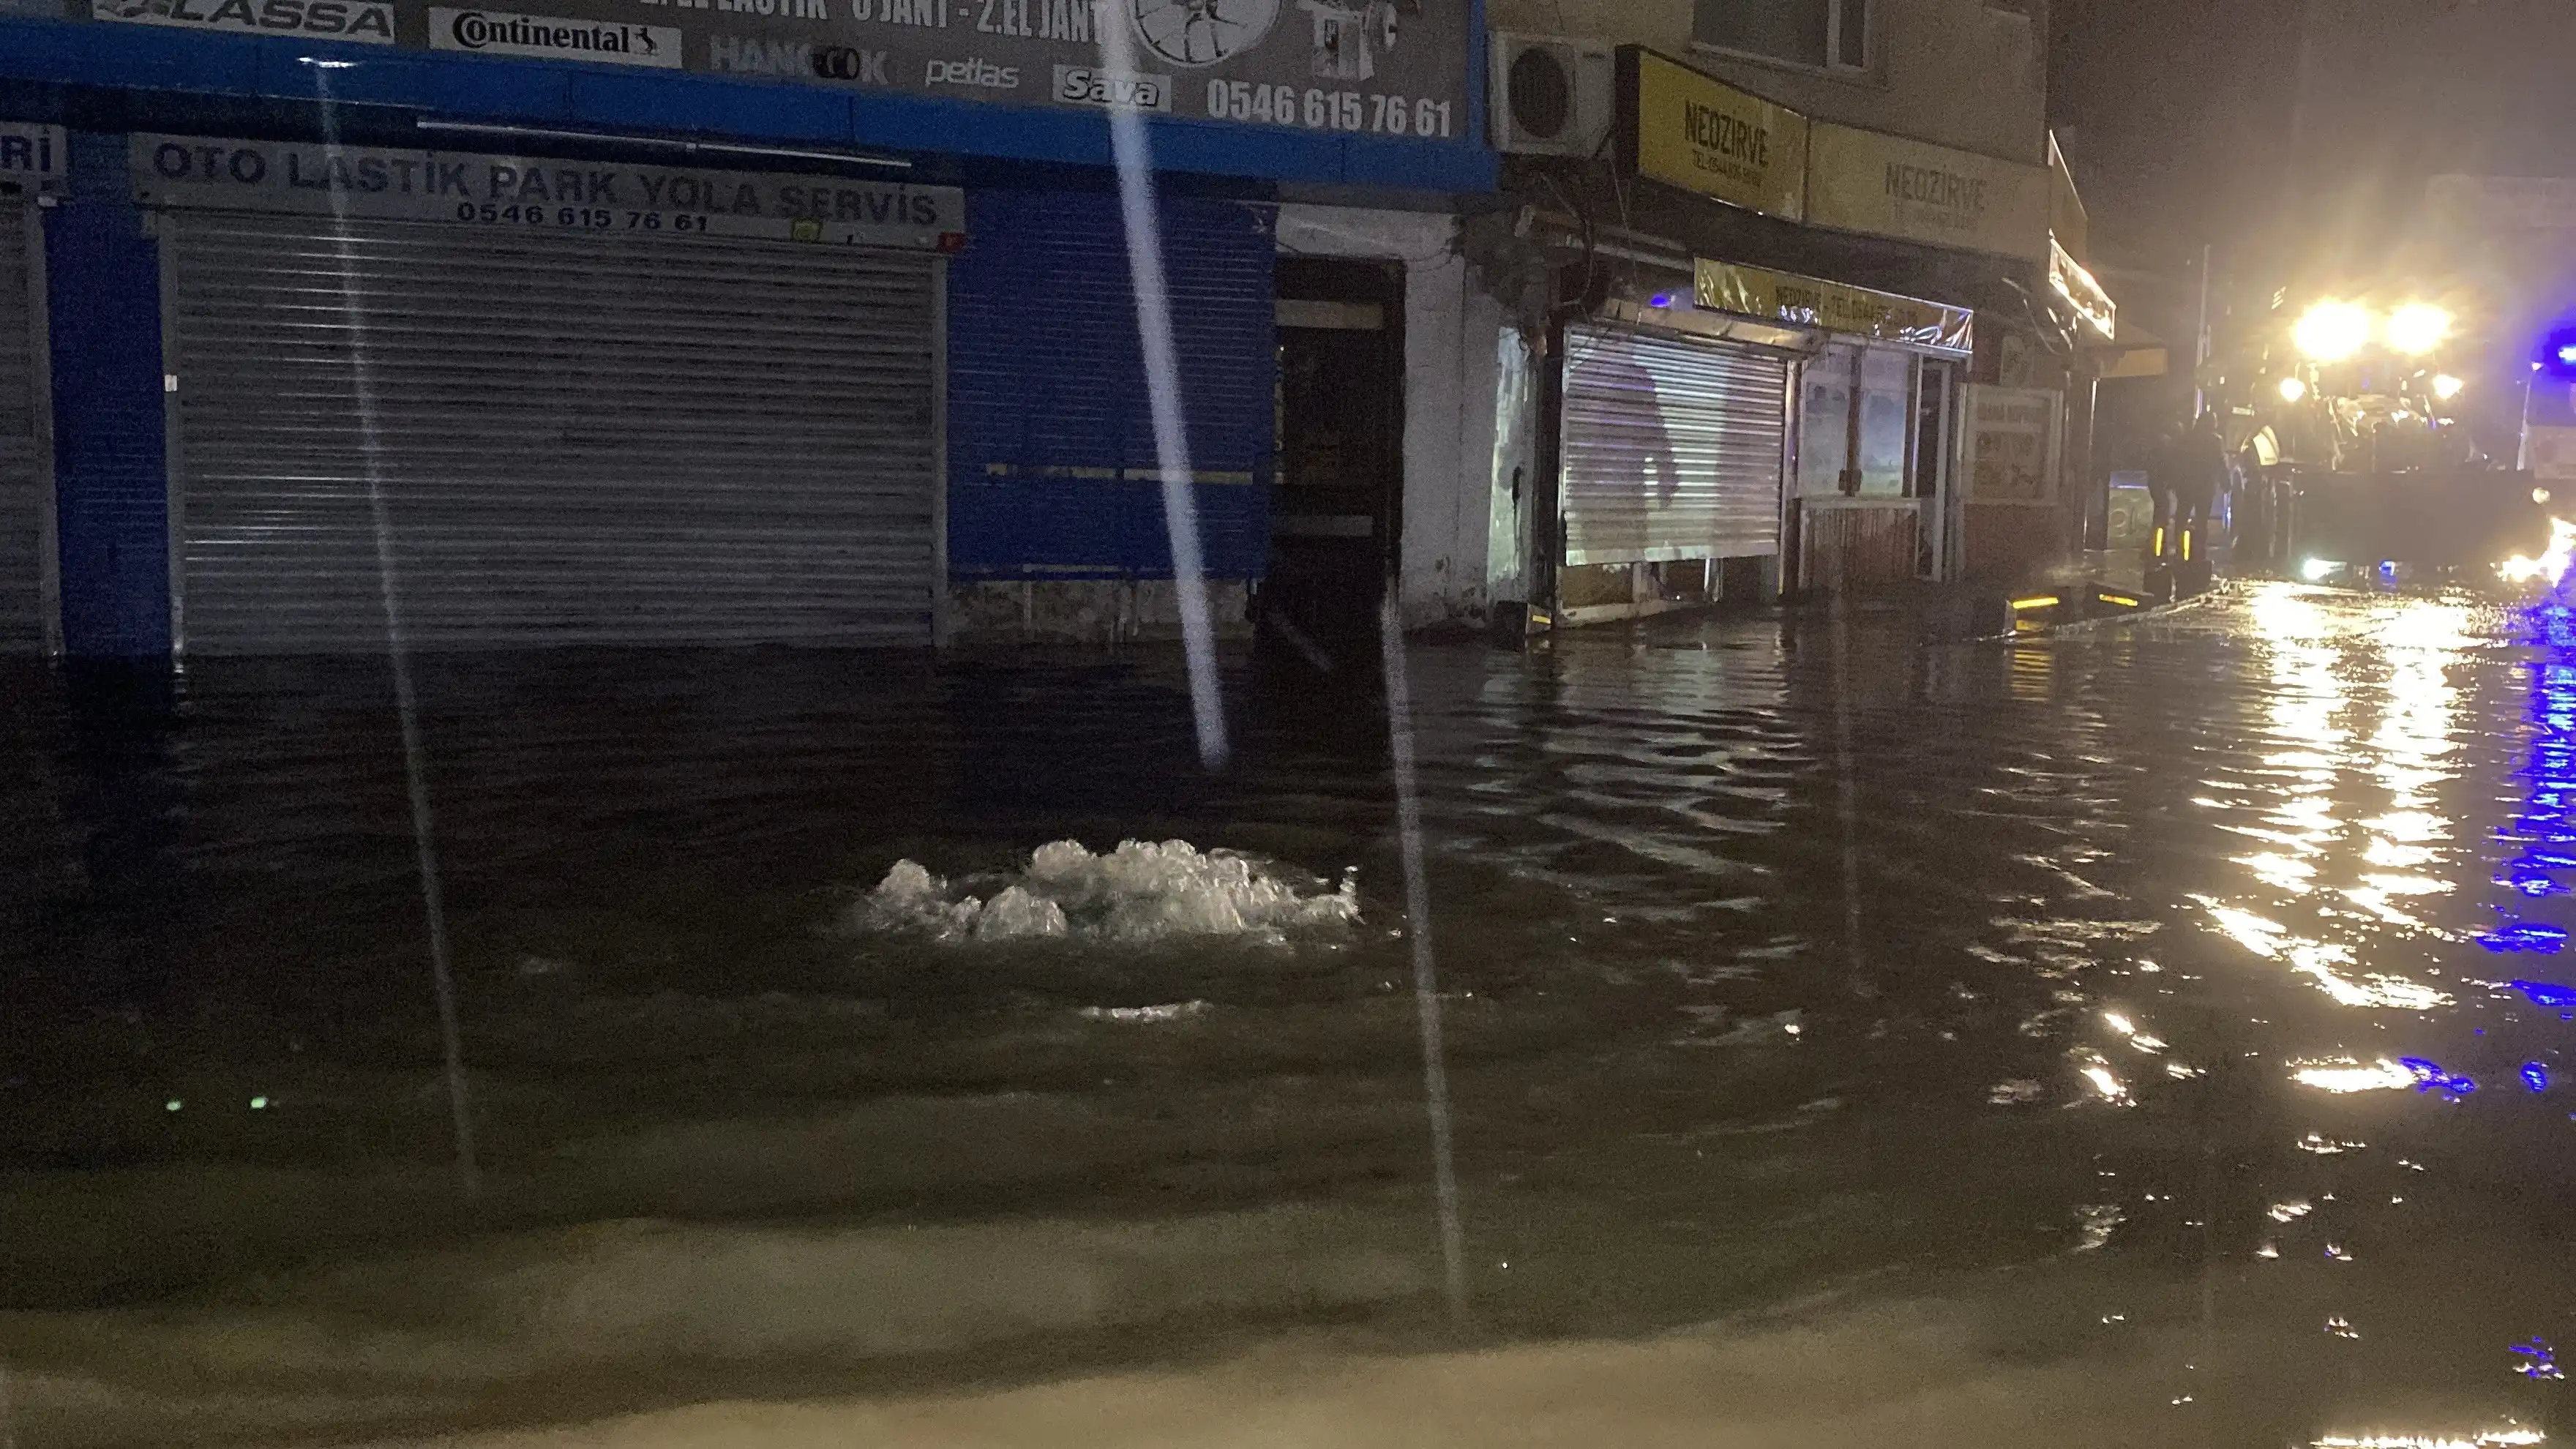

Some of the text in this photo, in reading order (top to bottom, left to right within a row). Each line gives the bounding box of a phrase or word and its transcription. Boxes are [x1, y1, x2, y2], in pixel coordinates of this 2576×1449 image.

[171, 0, 392, 37] LASSA
[452, 12, 629, 53] Continental
[925, 56, 1020, 89] petlas
[1063, 68, 1160, 108] Sava
[1207, 78, 1451, 138] 0546 615 76 61
[153, 141, 938, 227] OTO LASTİK PARK YOLA SERVİS
[457, 201, 708, 233] 0546 615 76 61
